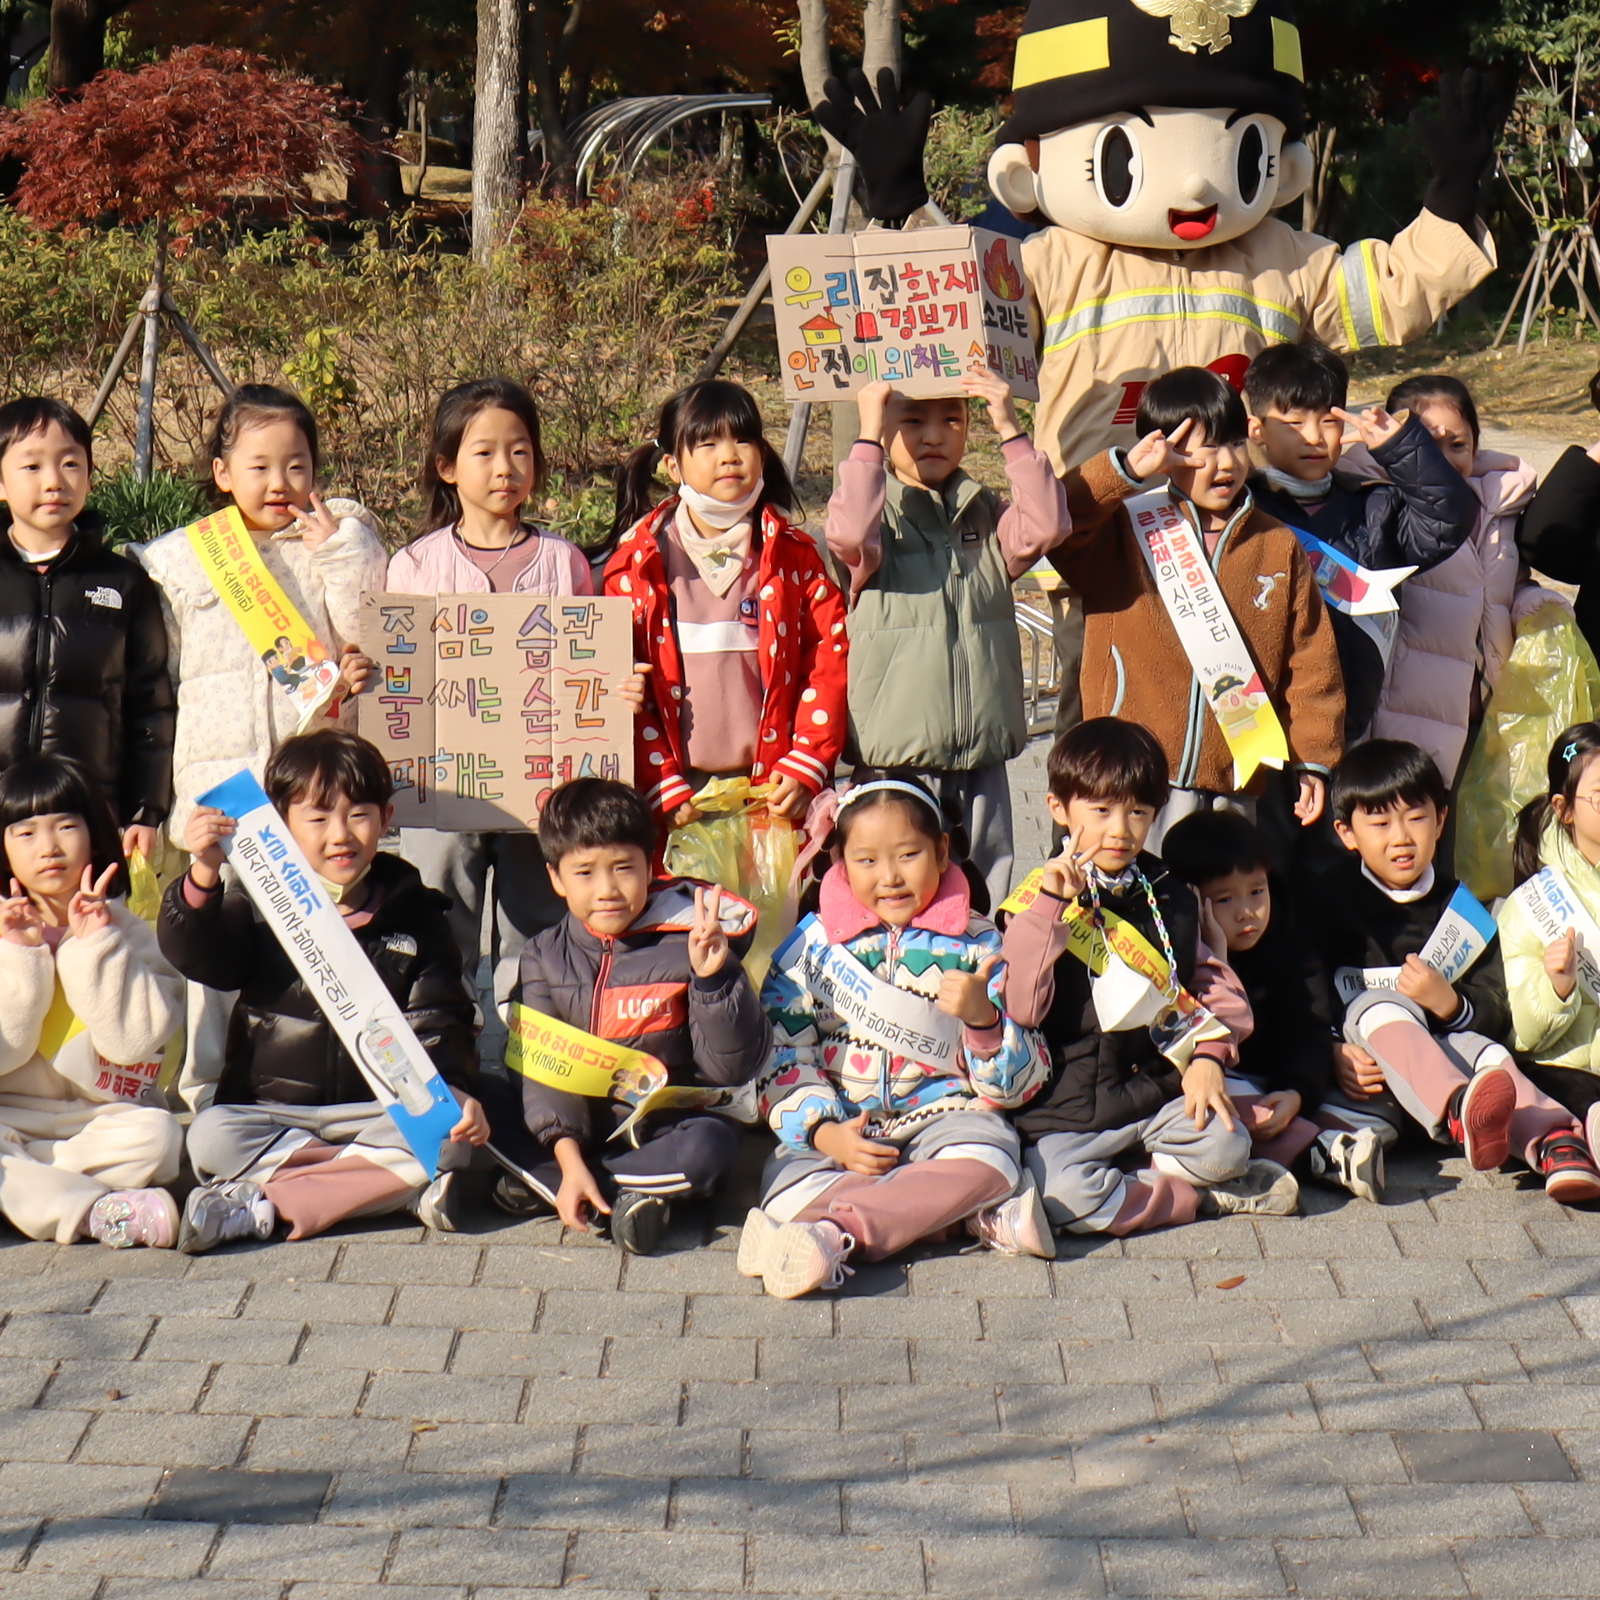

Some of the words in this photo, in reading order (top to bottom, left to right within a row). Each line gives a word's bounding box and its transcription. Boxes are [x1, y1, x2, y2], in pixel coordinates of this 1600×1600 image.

[880, 302, 968, 339] 경보기
[983, 305, 1029, 339] 소리는
[787, 344, 878, 392] 안전이
[881, 343, 962, 381] 외치는
[223, 571, 254, 613] 소중한
[1144, 526, 1180, 583] 화재의
[1172, 584, 1196, 619] 시작
[516, 603, 603, 668] 습관
[379, 666, 501, 739] 불씨는
[521, 677, 608, 734] 순간
[386, 748, 503, 803] 피해는
[258, 824, 290, 862] K급
[281, 861, 322, 916] 소화기
[1542, 880, 1575, 921] 소화기
[1453, 938, 1473, 968] K급
[831, 960, 873, 1001] 소화기
[531, 1048, 573, 1078] 소중한
